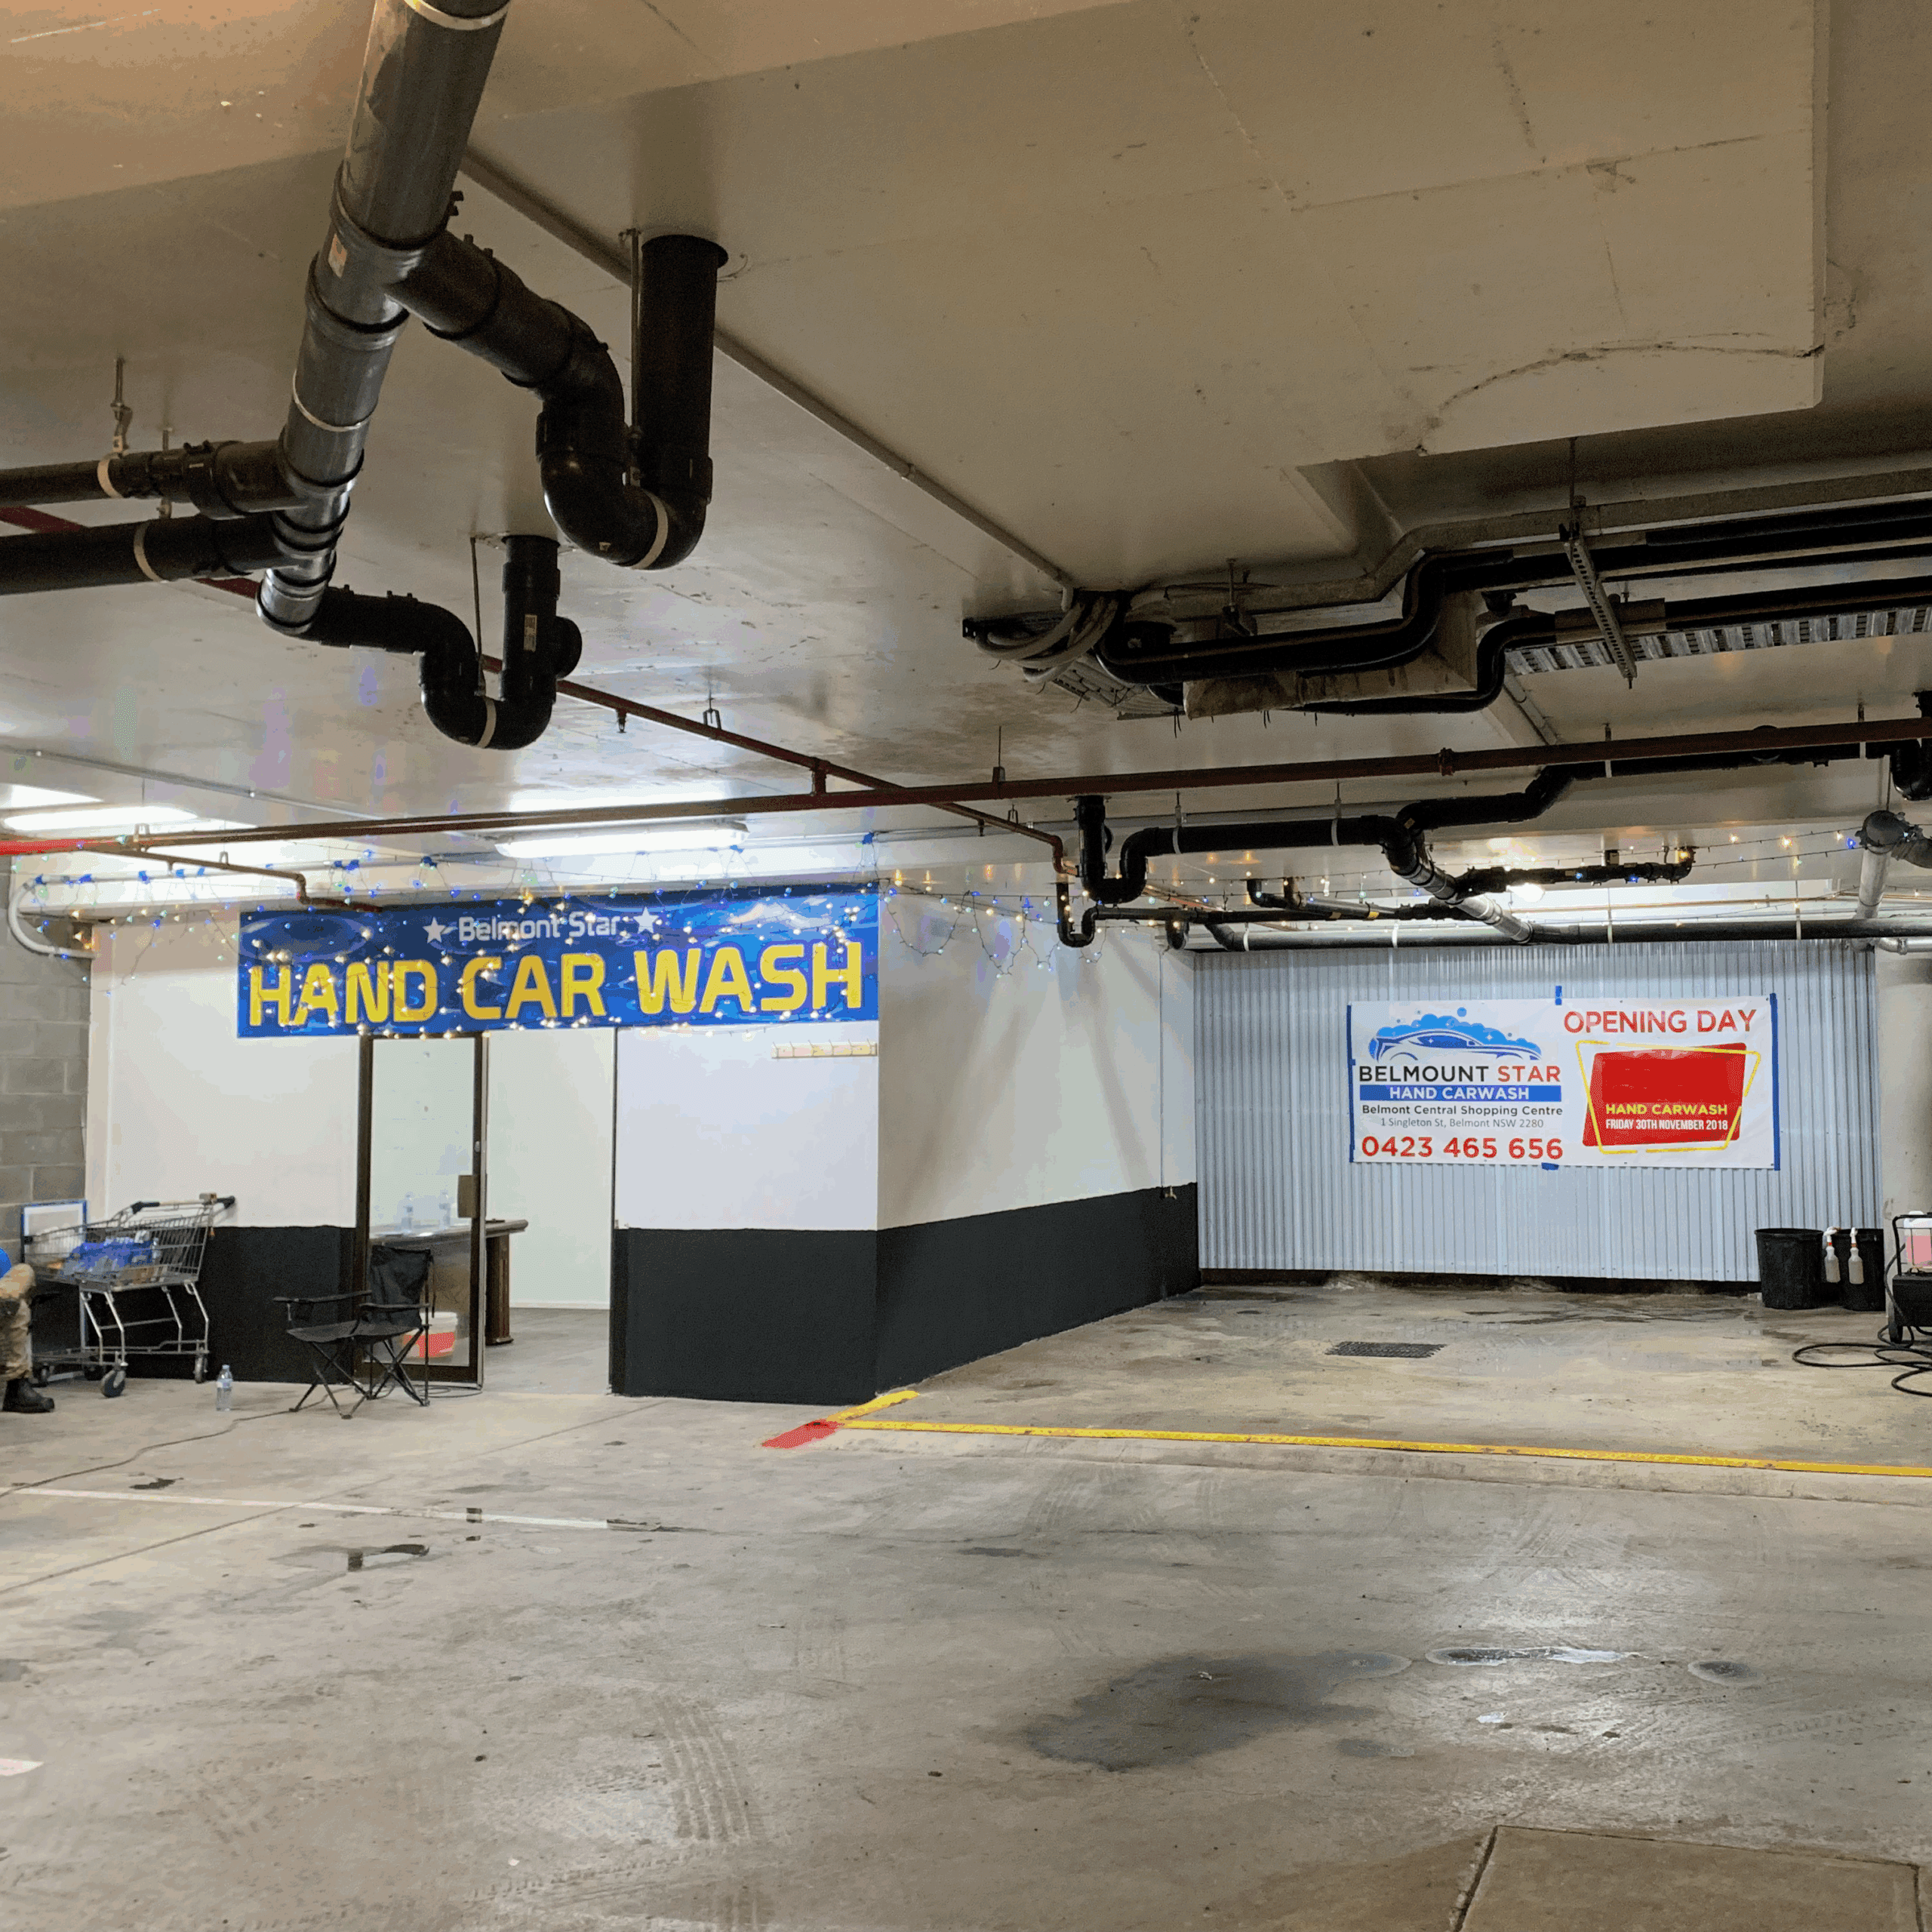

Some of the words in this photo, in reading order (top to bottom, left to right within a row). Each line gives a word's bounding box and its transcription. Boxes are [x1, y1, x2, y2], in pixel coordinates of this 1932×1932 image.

[459, 916, 561, 941] Belmont
[568, 911, 621, 937] Star
[249, 959, 438, 1026] HAND
[462, 952, 606, 1020] CAR
[633, 941, 862, 1014] WASH
[1564, 1010, 1687, 1033] OPENING
[1697, 1009, 1757, 1032] DAY
[1359, 1066, 1489, 1082] BELMOUNT
[1497, 1066, 1561, 1082] STAR
[1389, 1087, 1437, 1100] HAND
[1441, 1087, 1530, 1100] CARWASH
[1362, 1105, 1410, 1115] Belmont
[1414, 1105, 1457, 1115] Central
[1461, 1106, 1518, 1117] Shopping
[1521, 1106, 1563, 1116] Centre
[1605, 1103, 1647, 1115] HAND
[1651, 1104, 1728, 1115] CARWASH
[1381, 1118, 1386, 1126] 1
[1389, 1118, 1432, 1128] Singleton
[1449, 1118, 1491, 1128] Belmont
[1493, 1118, 1516, 1128] NSW
[1519, 1119, 1544, 1128] 2280
[1605, 1119, 1634, 1130] FRIDAY
[1635, 1119, 1657, 1130] 30TH
[1659, 1120, 1704, 1131] NOVEMBER
[1706, 1120, 1728, 1131] 2018
[1361, 1136, 1433, 1158] 0423
[1443, 1137, 1497, 1158] 465
[1509, 1137, 1564, 1160] 656
